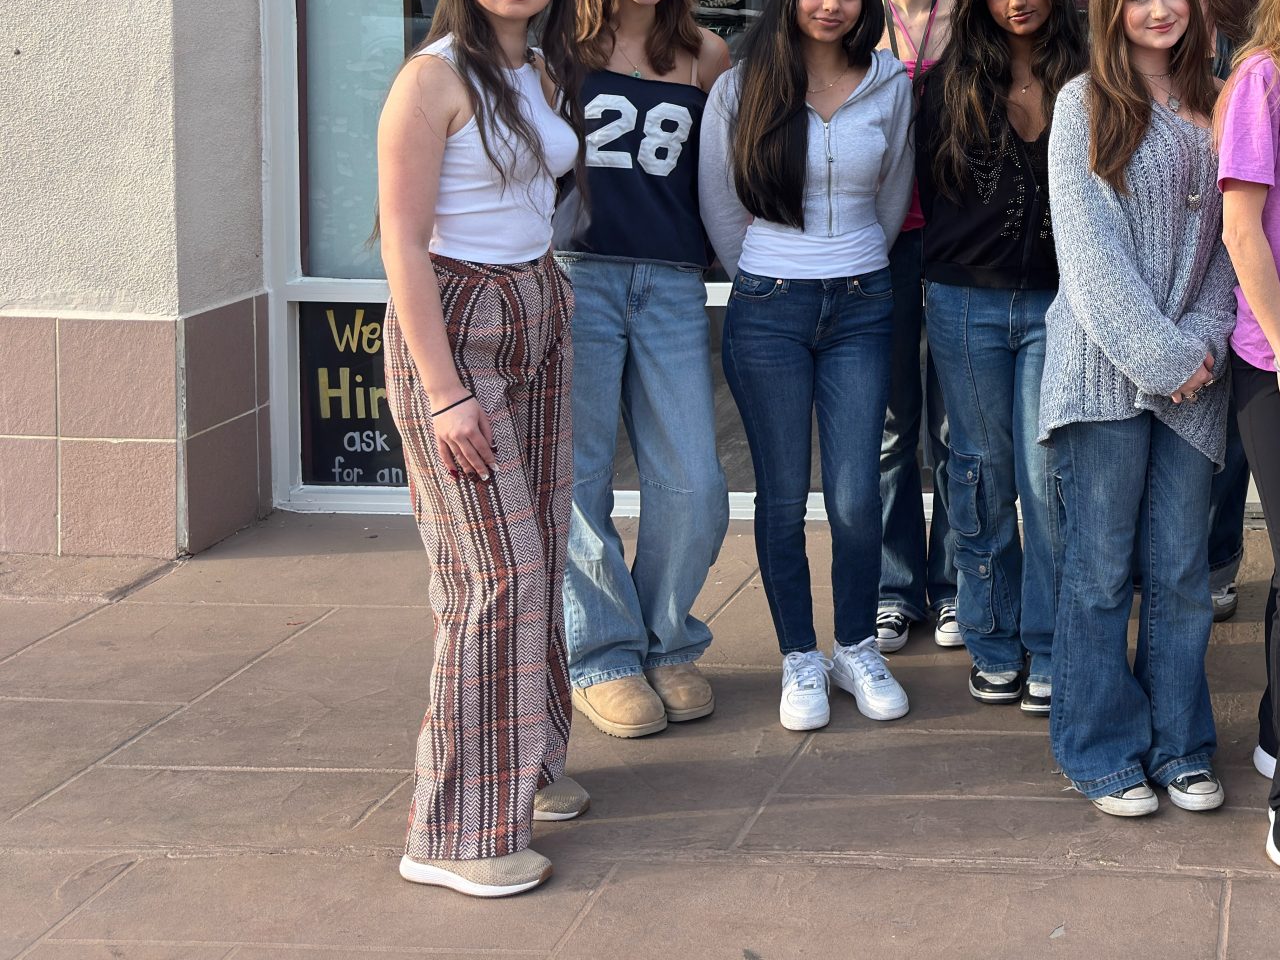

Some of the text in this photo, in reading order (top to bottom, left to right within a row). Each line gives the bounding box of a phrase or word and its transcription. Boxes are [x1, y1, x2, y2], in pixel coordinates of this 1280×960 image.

[584, 93, 693, 177] 28
[325, 309, 382, 354] We
[317, 367, 388, 419] Hir
[343, 430, 391, 452] ask
[331, 456, 364, 483] for
